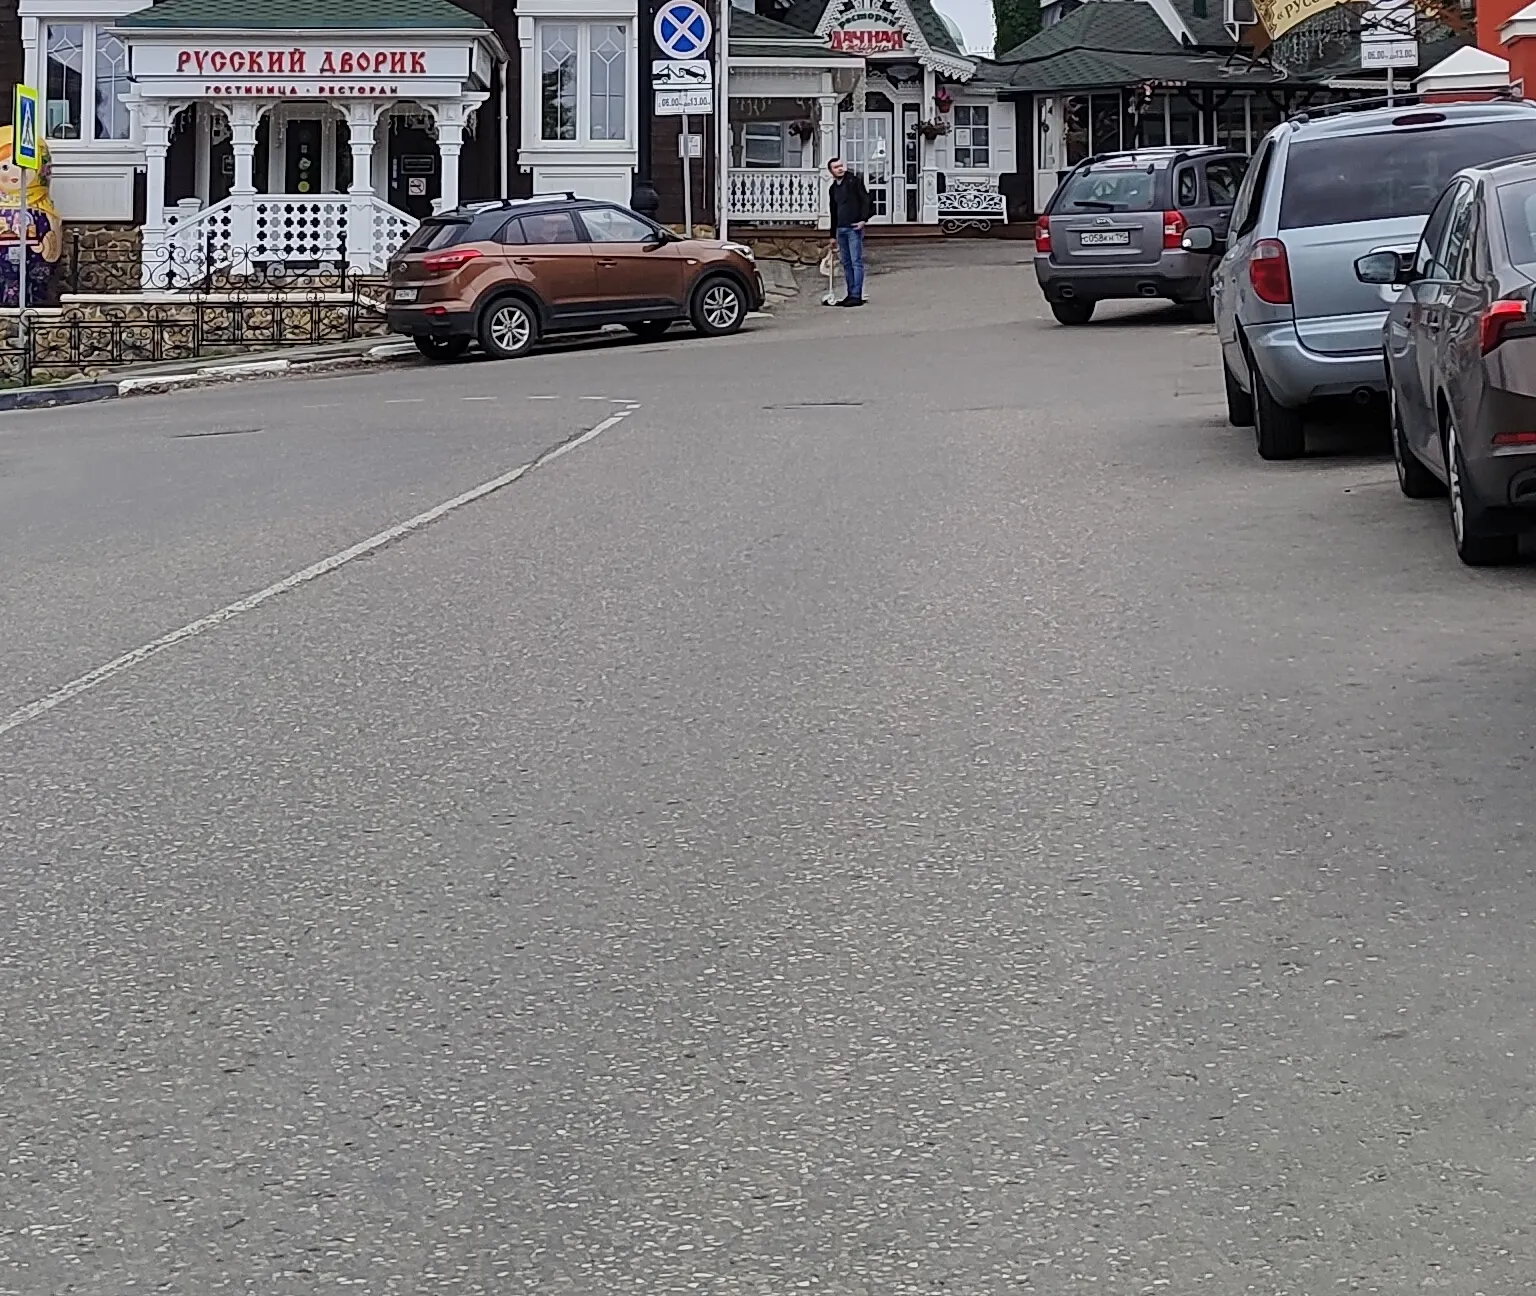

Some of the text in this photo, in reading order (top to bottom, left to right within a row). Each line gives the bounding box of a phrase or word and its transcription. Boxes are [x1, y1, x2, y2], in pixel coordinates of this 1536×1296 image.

[175, 48, 427, 75] РУССКИЙ ДВОРИК
[204, 85, 398, 96] ГОСТИНИЦА РЕСТОРАН
